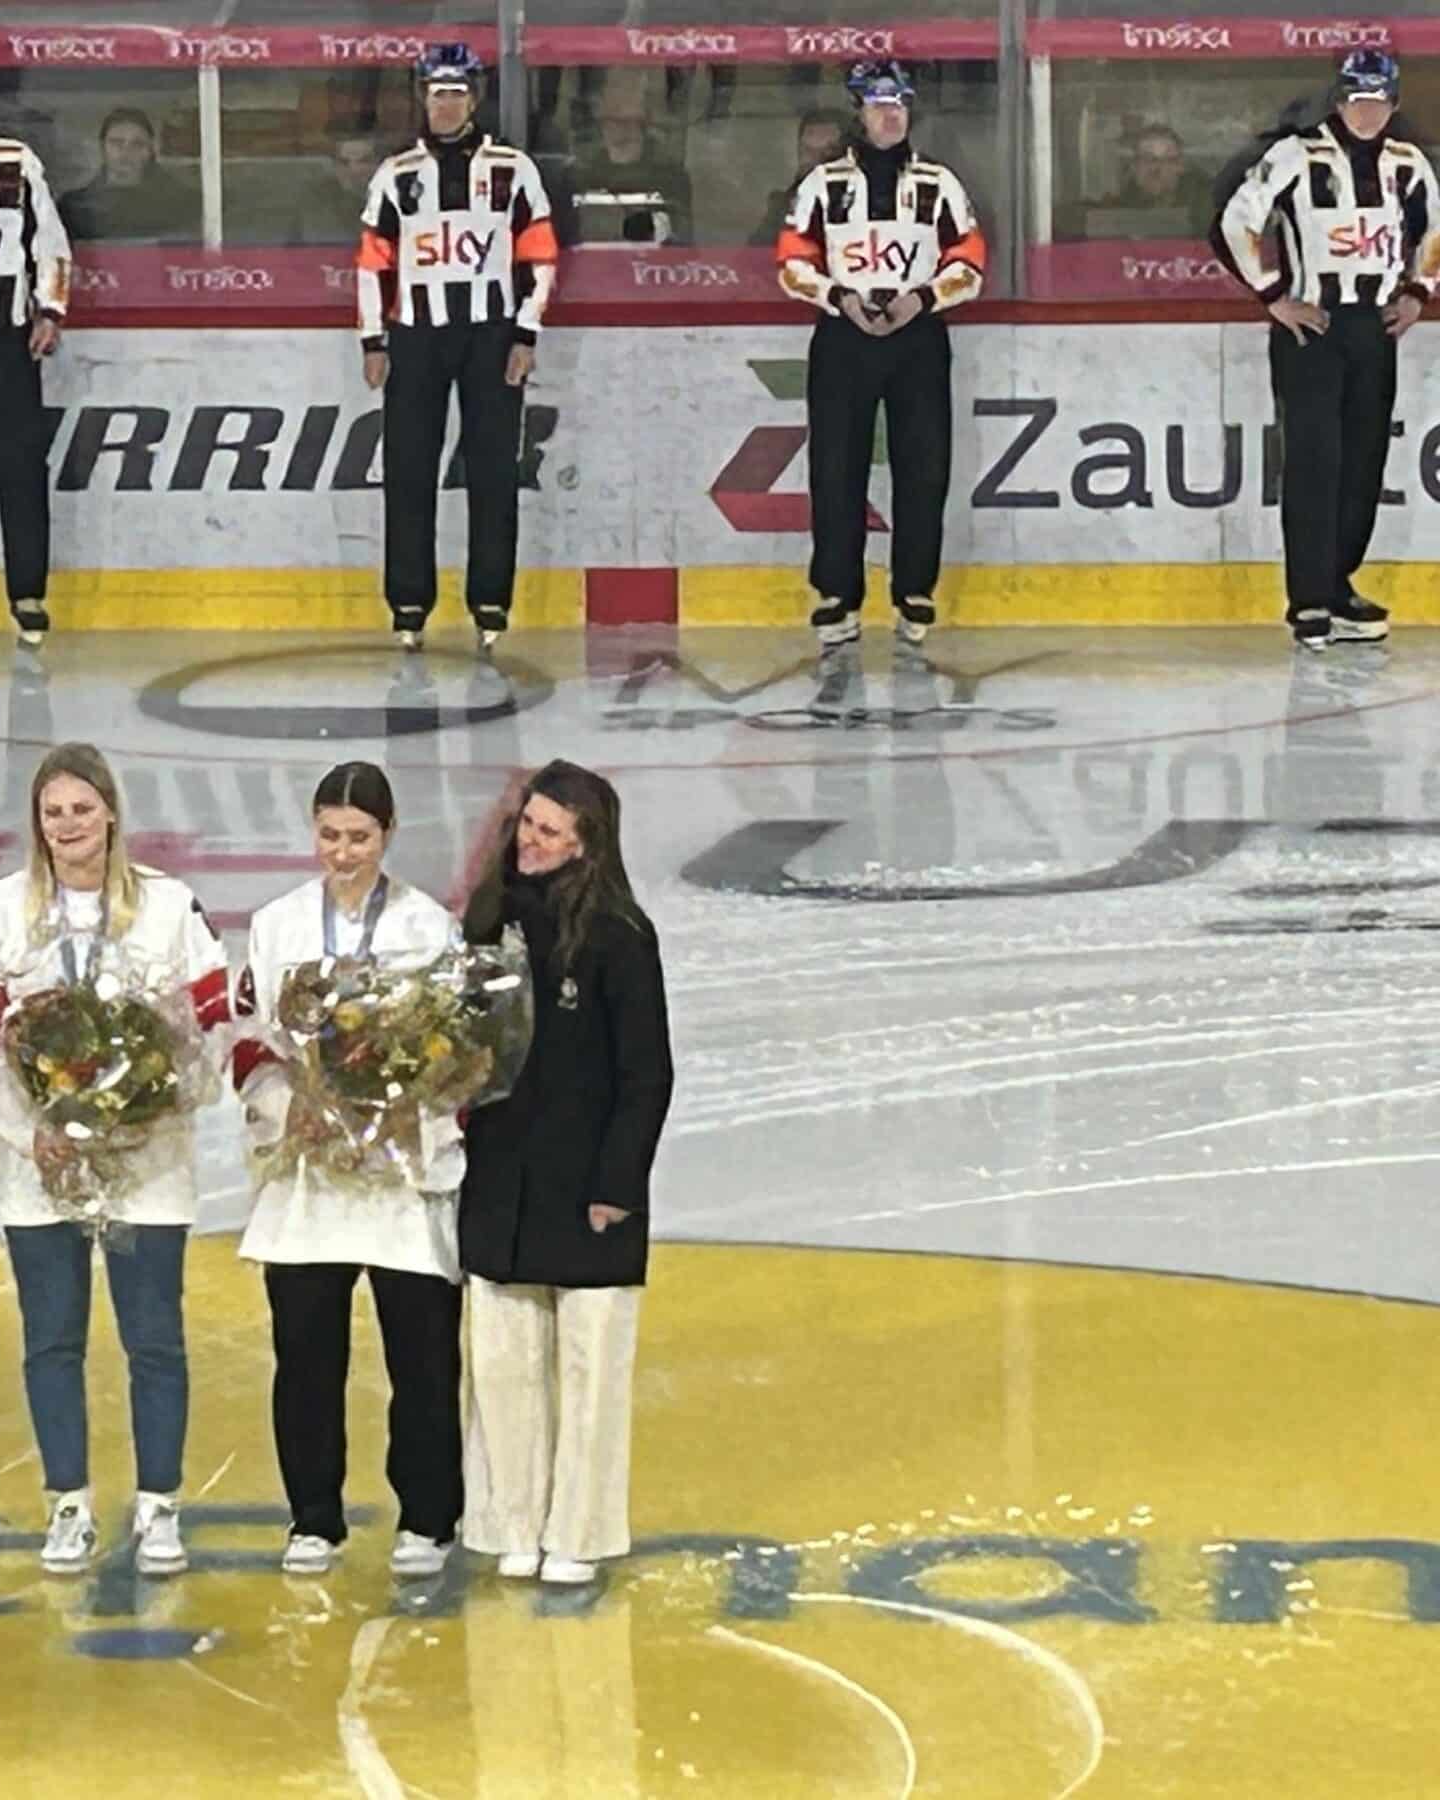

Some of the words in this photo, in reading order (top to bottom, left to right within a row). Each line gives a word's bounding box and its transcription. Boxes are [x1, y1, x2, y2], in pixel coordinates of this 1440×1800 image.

[415, 220, 496, 275] sky
[842, 228, 920, 282] sky
[971, 397, 1440, 508] Zau
